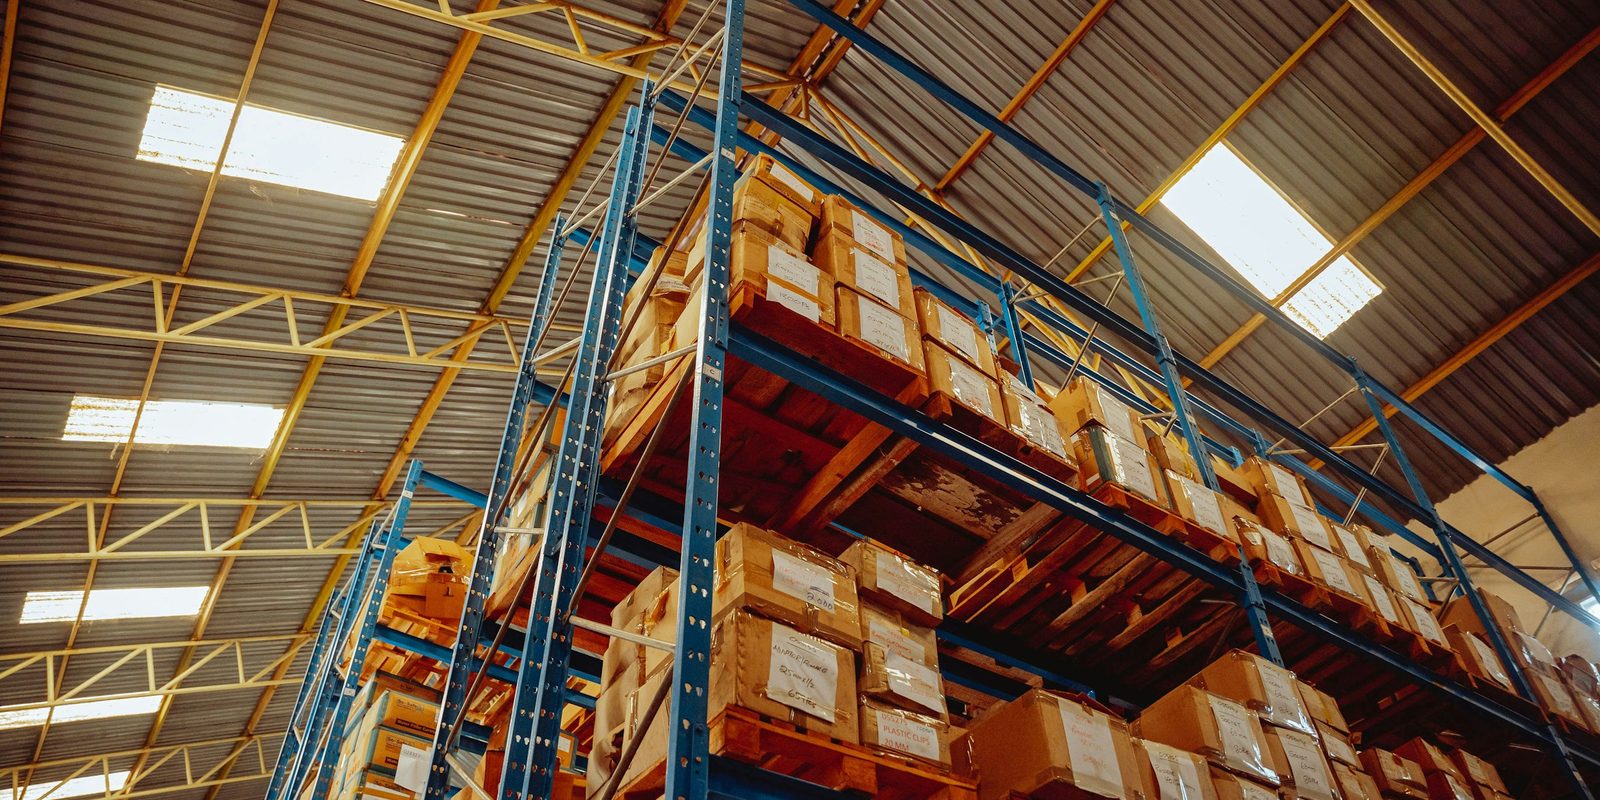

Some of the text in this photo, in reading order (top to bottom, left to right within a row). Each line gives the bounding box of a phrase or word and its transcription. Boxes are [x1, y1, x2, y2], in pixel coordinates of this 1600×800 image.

[883, 725, 912, 740] PLASTIC
[912, 733, 930, 746] CLIPS
[883, 738, 909, 752] 20 MM
